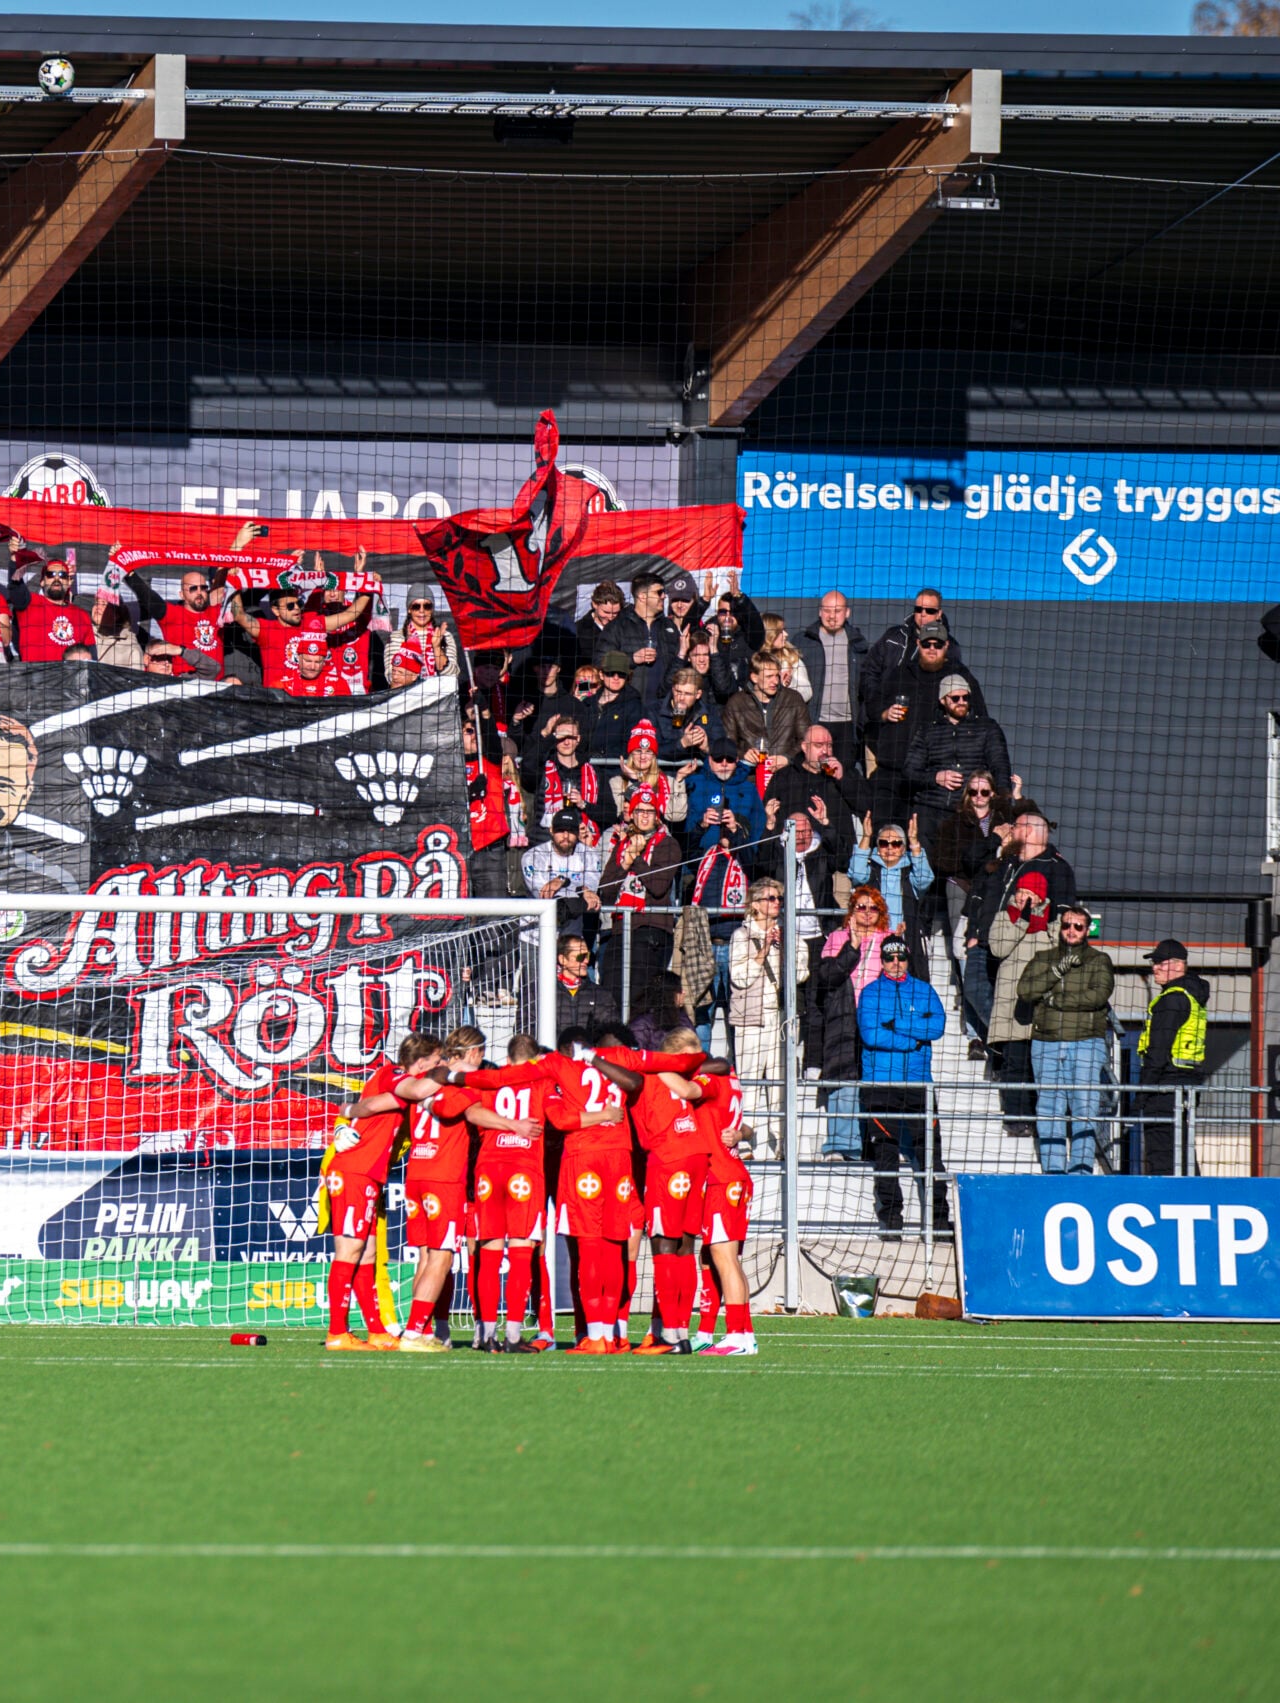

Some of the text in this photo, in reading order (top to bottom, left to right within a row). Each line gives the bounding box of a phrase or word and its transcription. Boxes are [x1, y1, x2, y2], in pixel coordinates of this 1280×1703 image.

[743, 471, 952, 511] Rörelsens
[965, 474, 1103, 521] glädje
[131, 954, 446, 1090] Rött
[494, 1086, 532, 1121] 91
[95, 1202, 188, 1233] PELIN
[83, 1237, 201, 1262] PAIKKA
[1042, 1201, 1269, 1288] OSTP
[54, 1277, 214, 1309] SUBWAY
